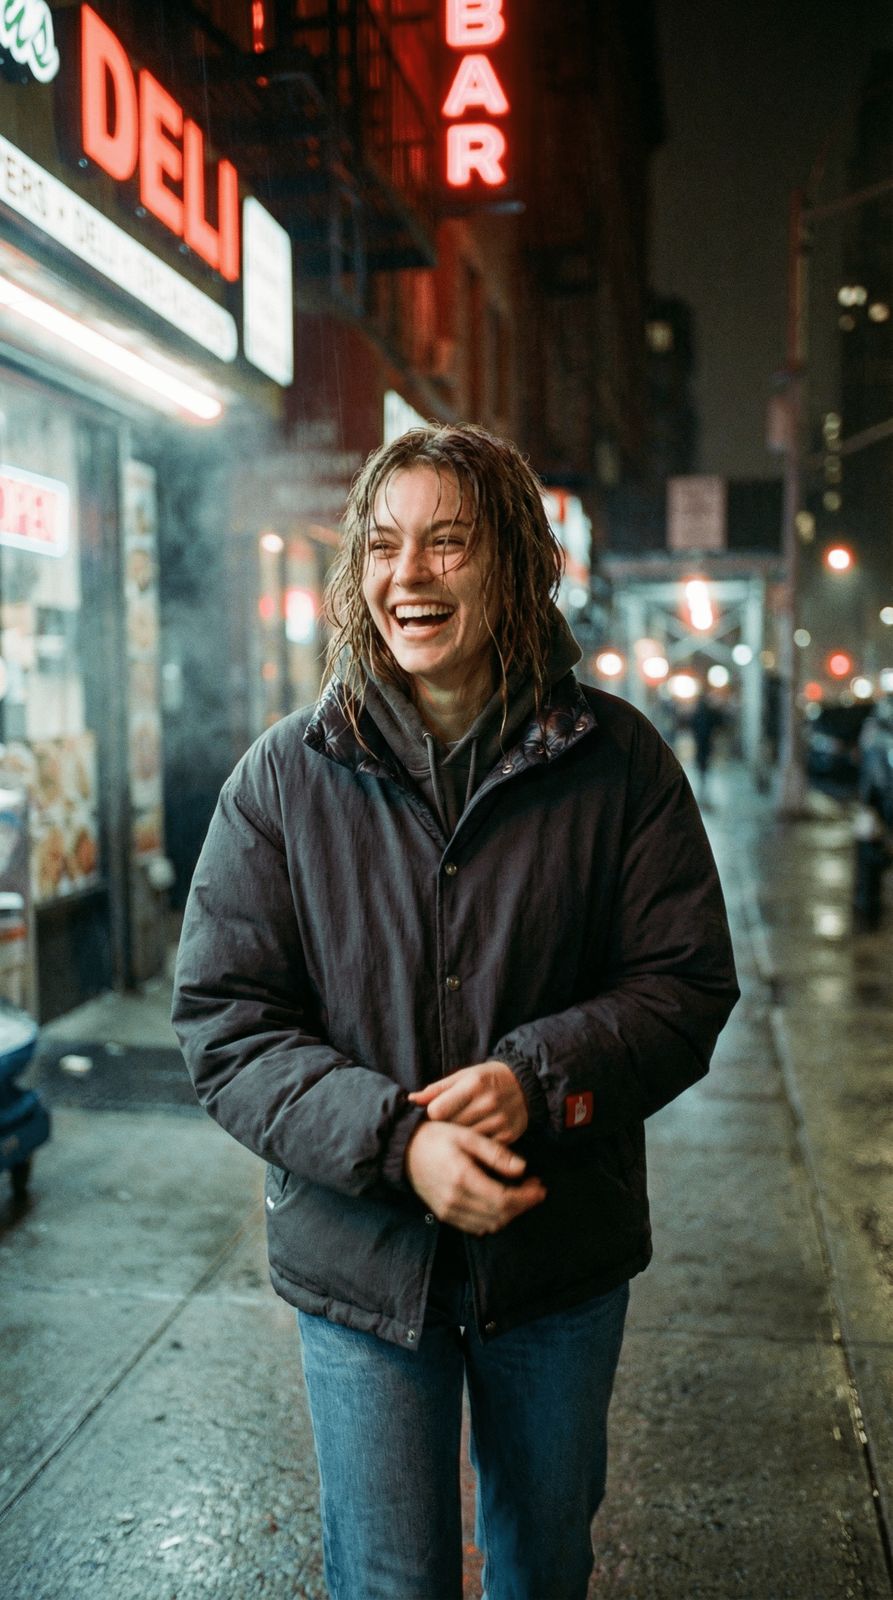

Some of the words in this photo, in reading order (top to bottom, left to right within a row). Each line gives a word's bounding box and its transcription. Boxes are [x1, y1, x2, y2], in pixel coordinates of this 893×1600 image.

[0, 147, 48, 217] ERS
[80, 2, 240, 283] DELI
[442, 0, 510, 187] BAR
